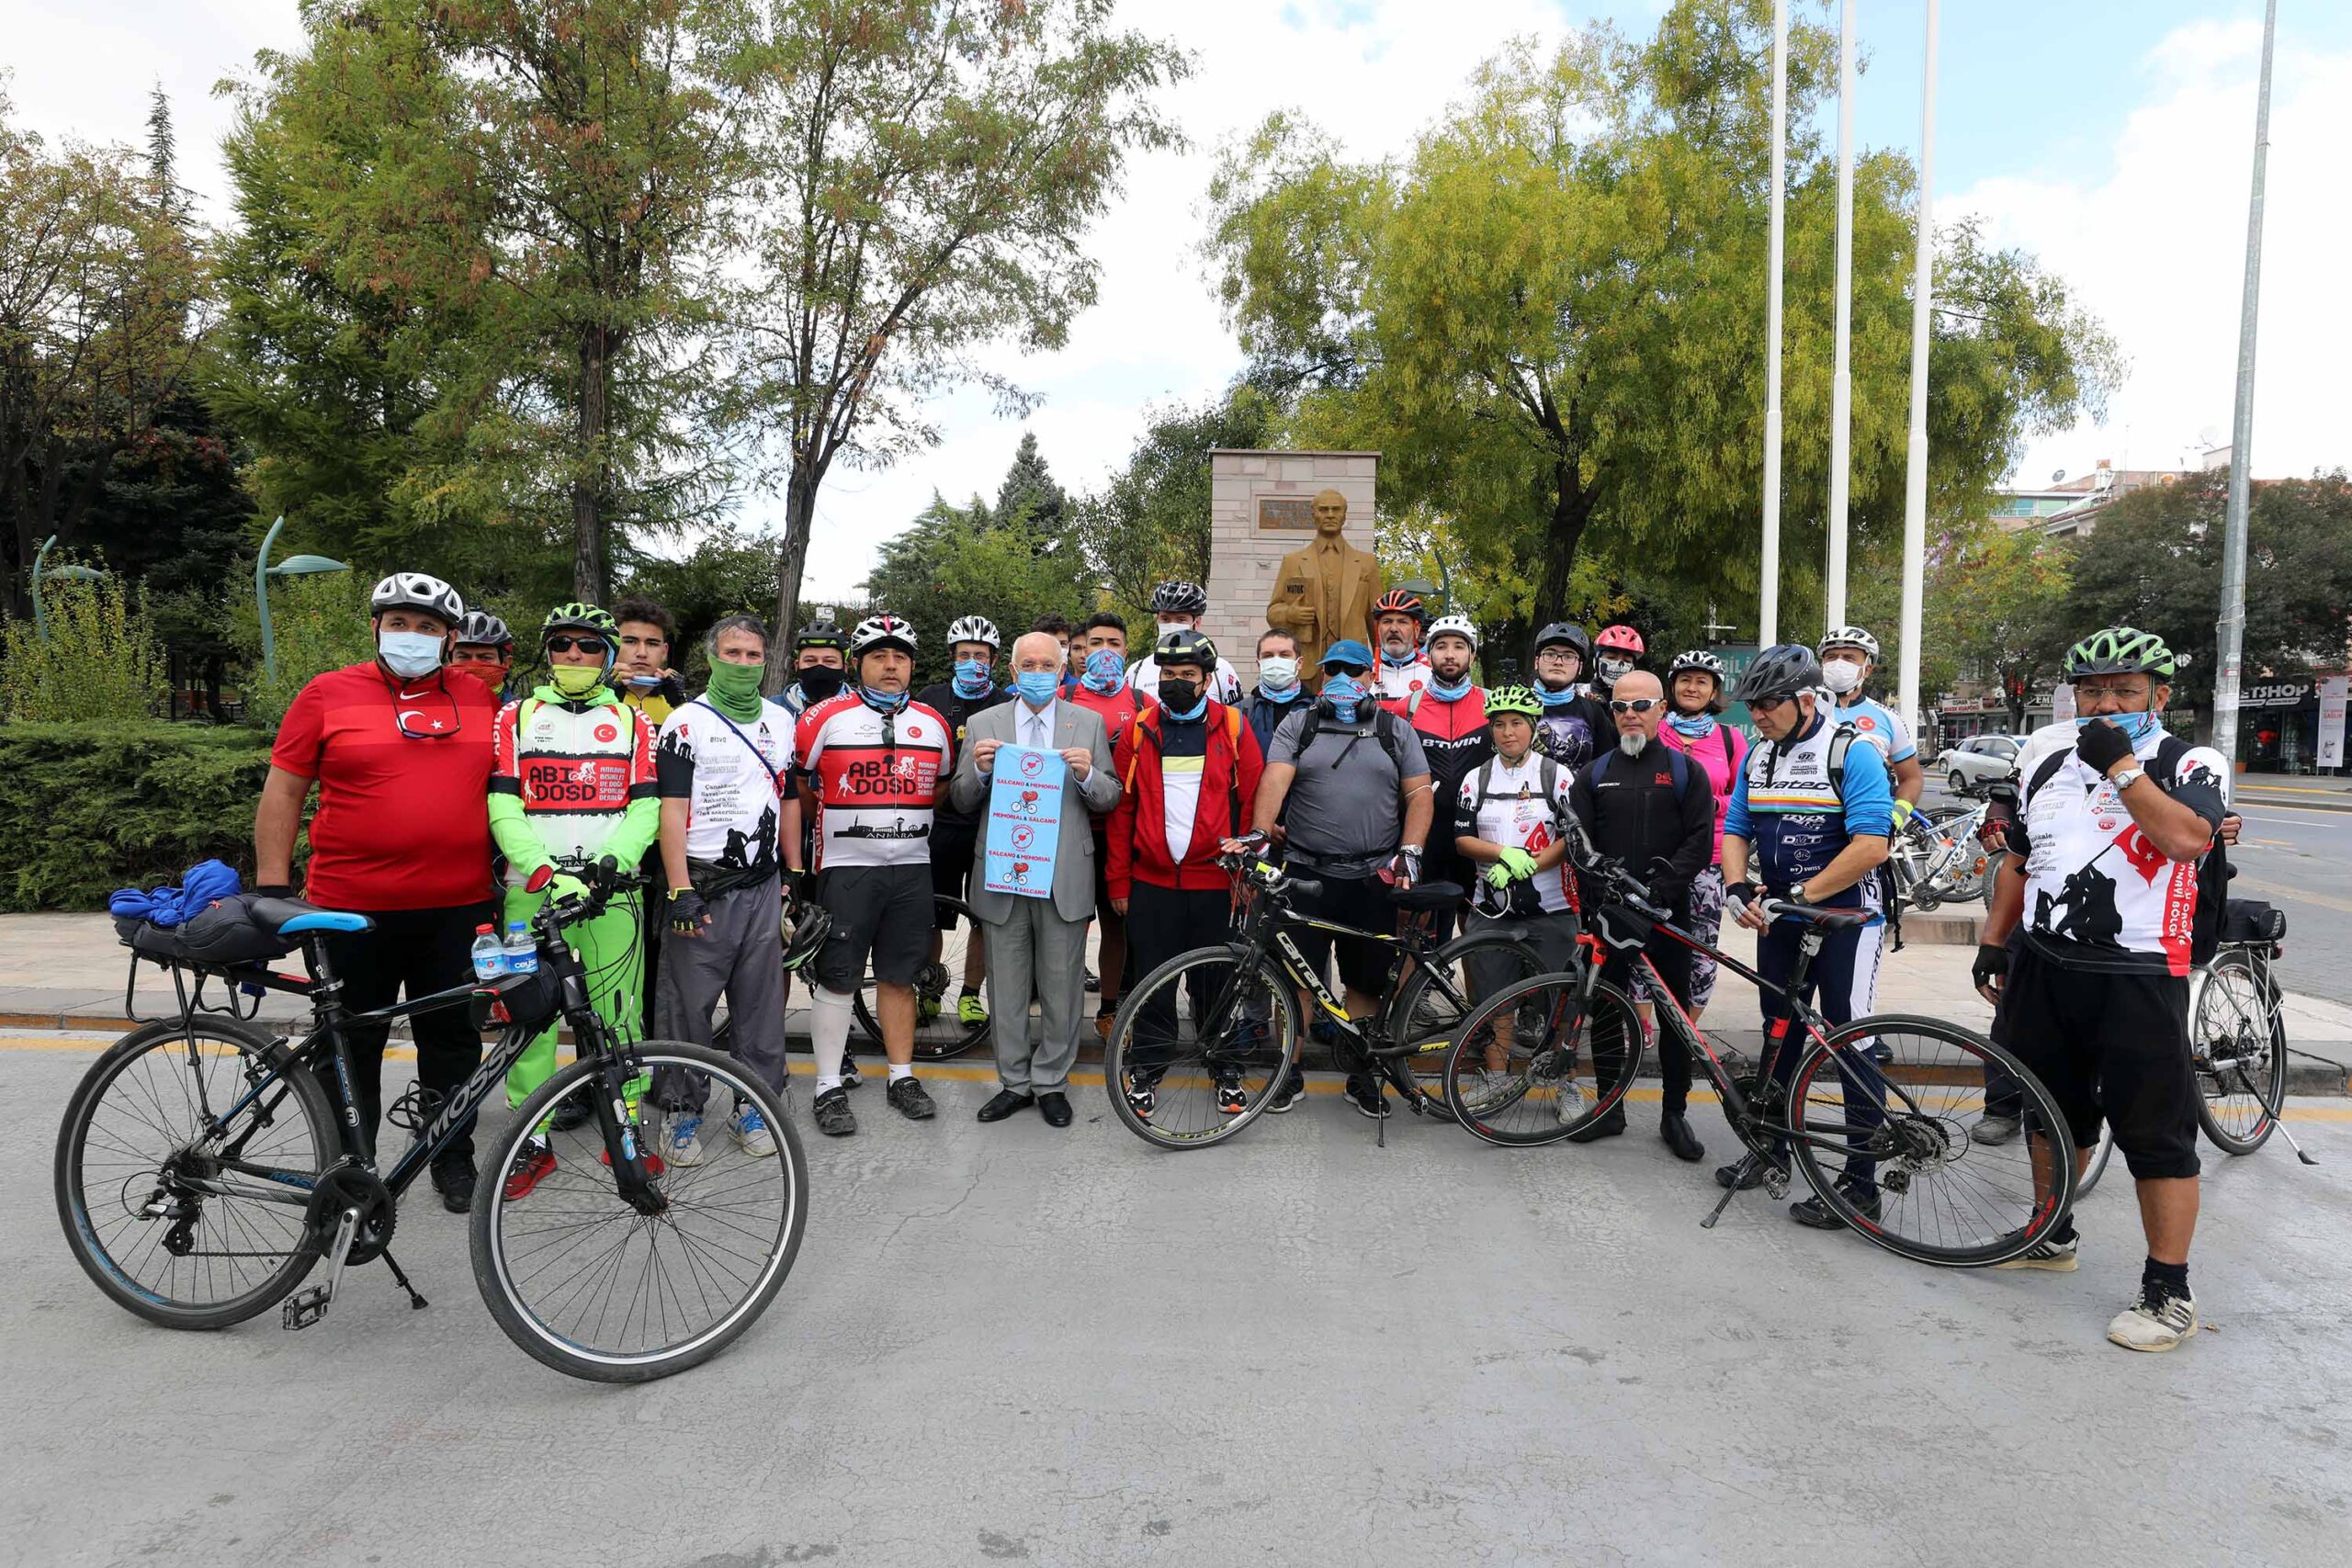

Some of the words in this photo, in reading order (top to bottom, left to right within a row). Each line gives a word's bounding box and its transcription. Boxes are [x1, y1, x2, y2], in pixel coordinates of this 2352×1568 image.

[2240, 683, 2310, 699] ETSHOP
[804, 694, 854, 727] ABIDOSD
[492, 700, 522, 757] ABIDO
[855, 777, 916, 795] DOSD
[996, 778, 1025, 787] SALCANO
[536, 784, 596, 801] DOSD
[816, 774, 825, 857] ABIDOSD
[992, 812, 1023, 820] MEMORIAL
[989, 850, 1016, 858] SALCANO
[986, 883, 1014, 891] MEMORIAL
[1019, 887, 1047, 896] SALCANO
[1633, 964, 1712, 1061] MOSSO
[427, 1024, 526, 1149] MOSSO
